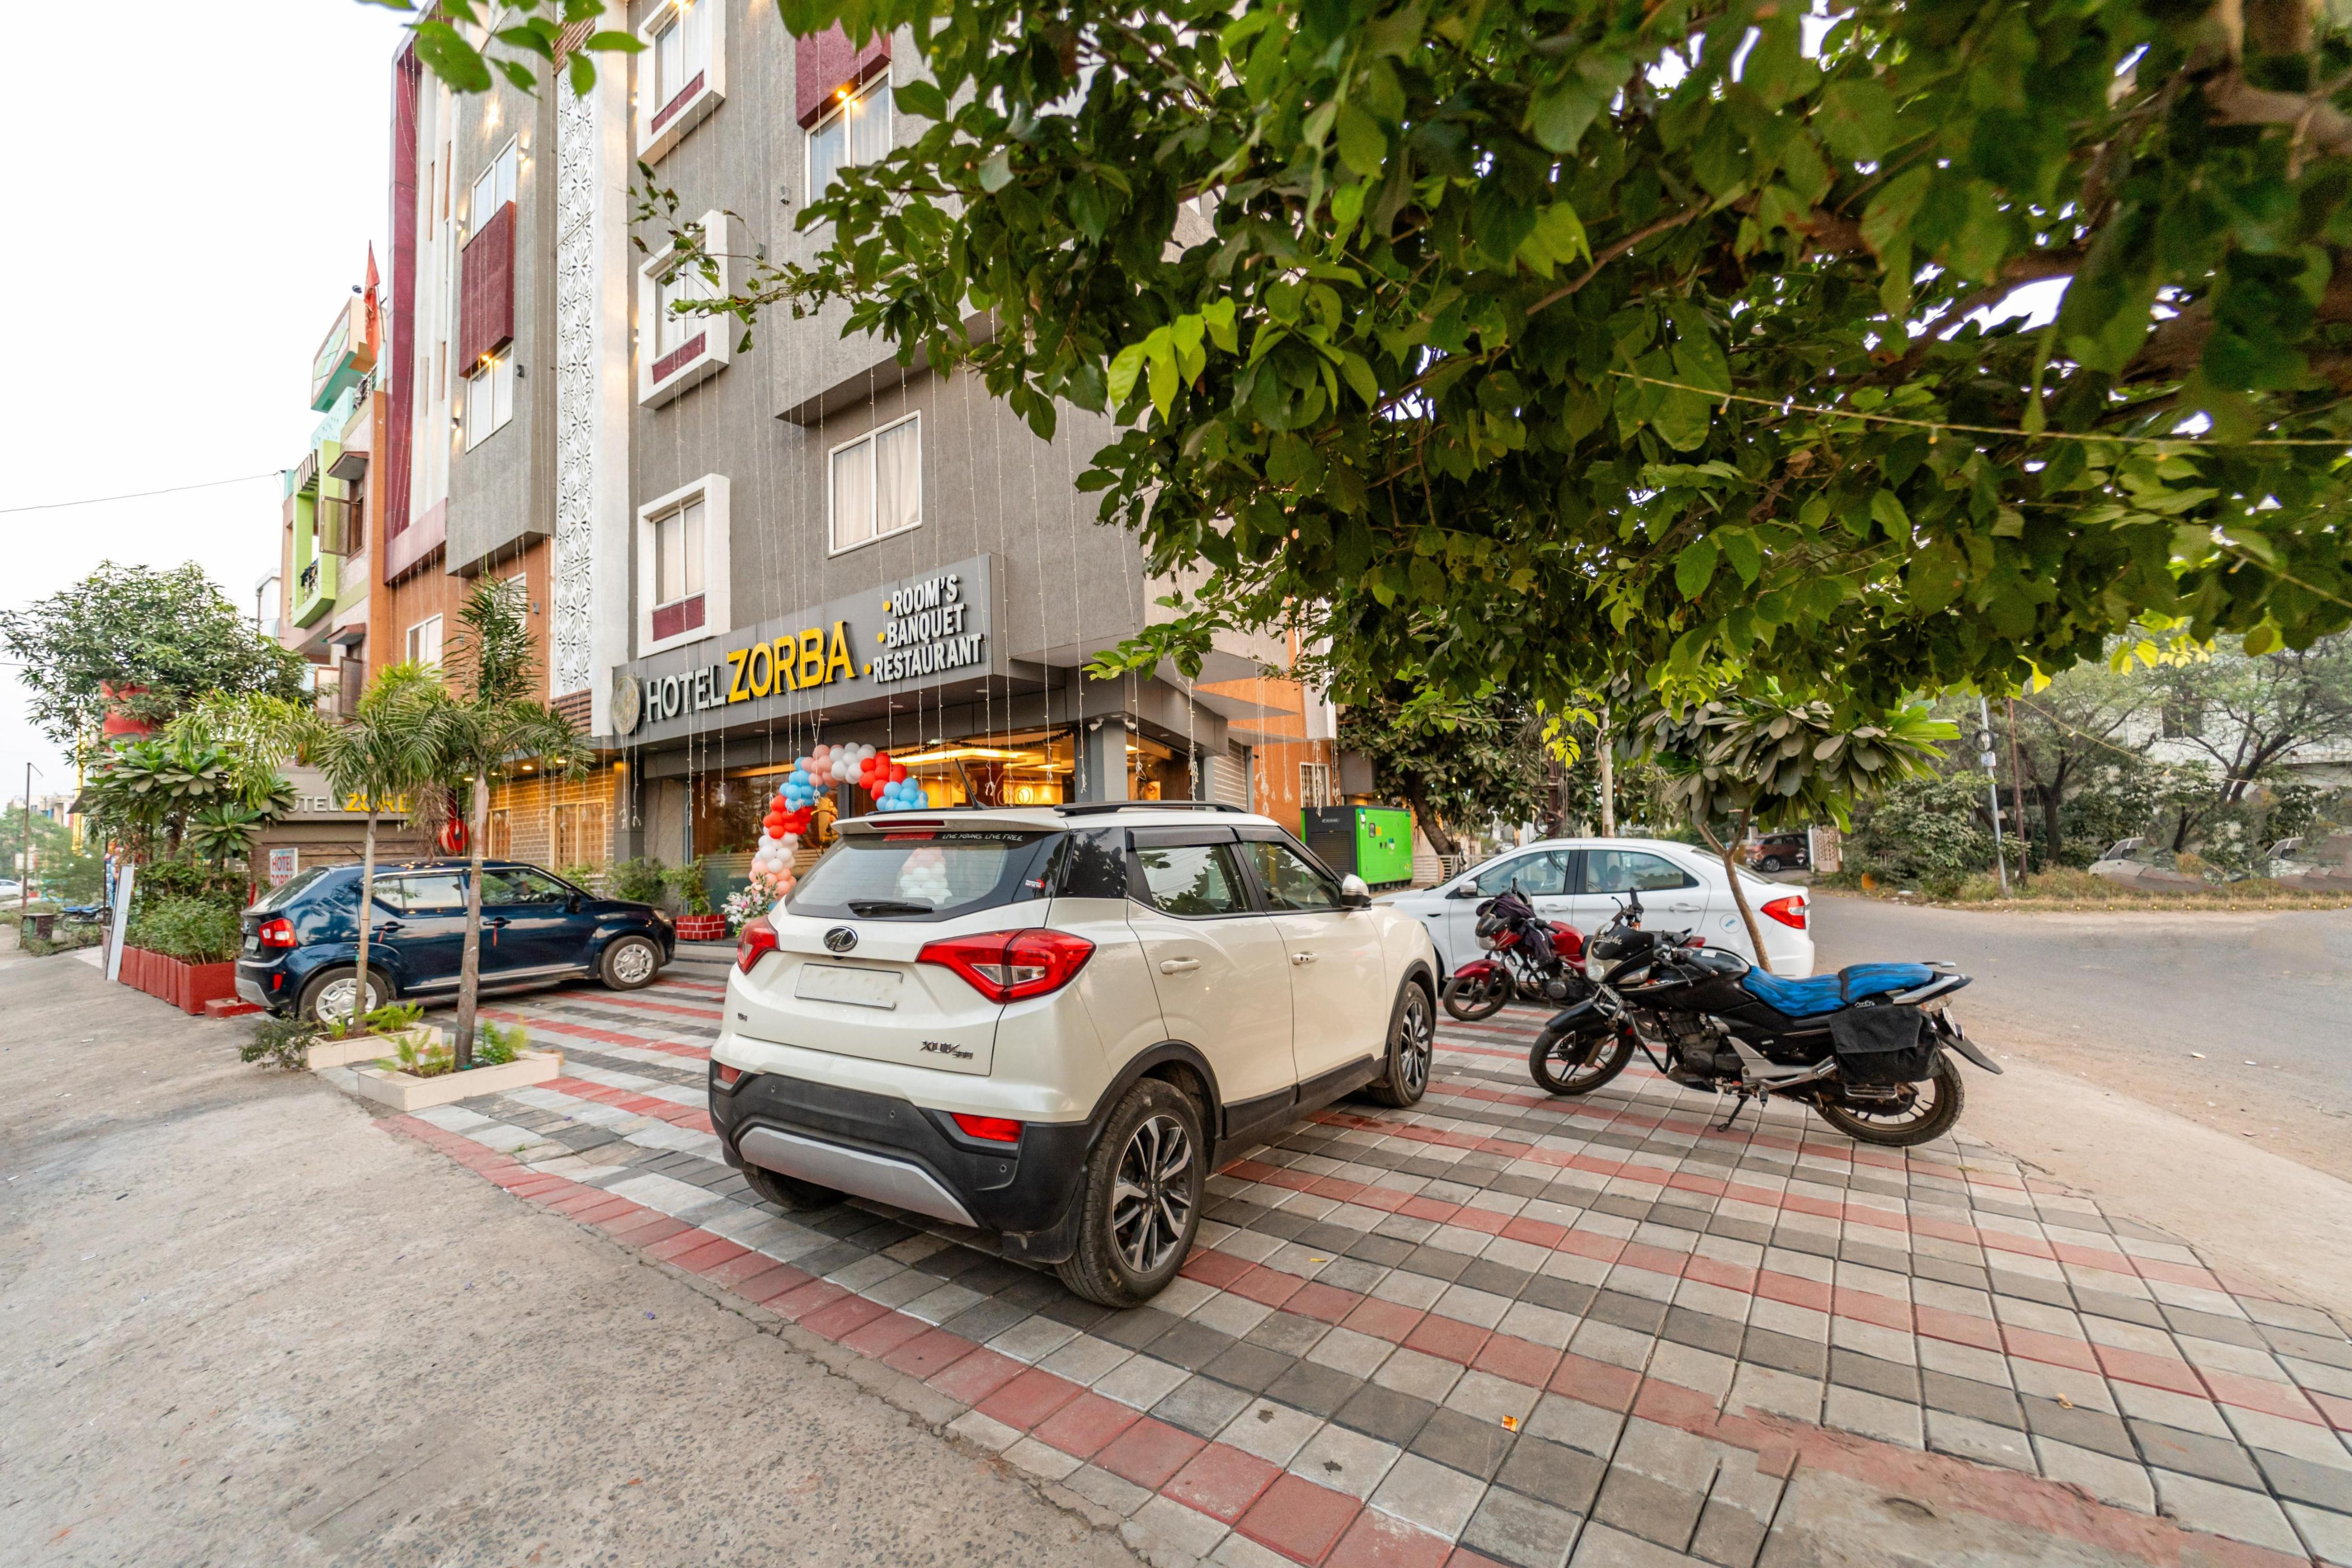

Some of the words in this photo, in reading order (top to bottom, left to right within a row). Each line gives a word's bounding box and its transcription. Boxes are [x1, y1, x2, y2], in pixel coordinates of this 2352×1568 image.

[887, 603, 965, 649] BANQUET
[646, 664, 727, 722] HOTEL
[727, 620, 856, 704] ZORBA
[873, 633, 982, 683] RESTAURANT
[272, 856, 293, 871] HOTEL
